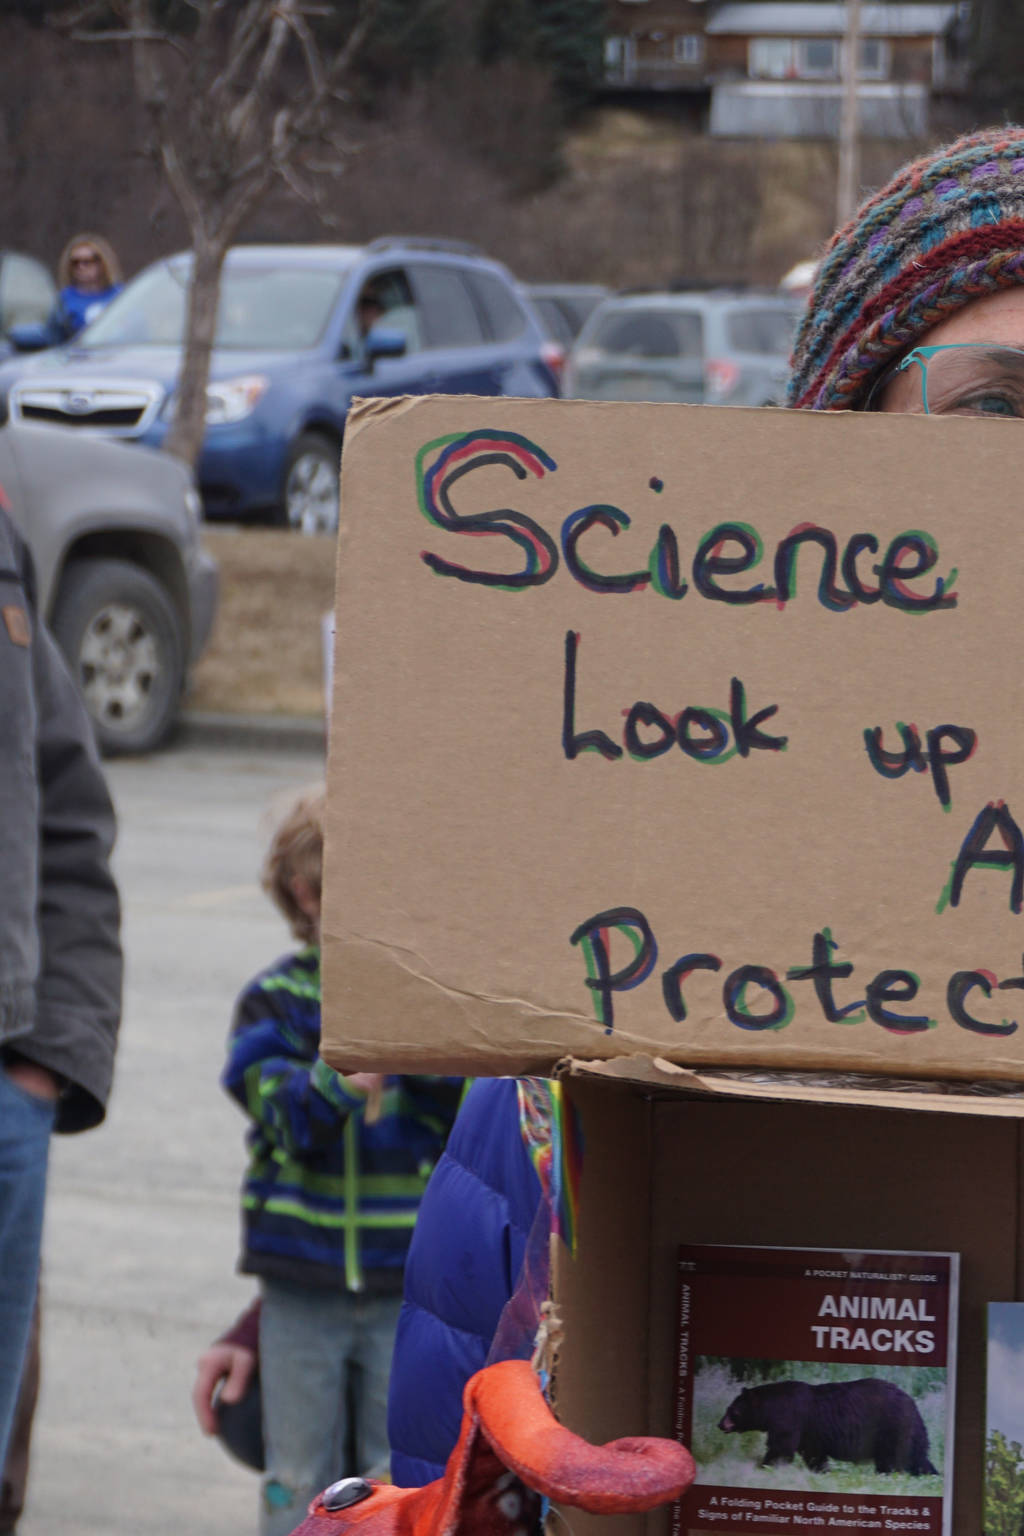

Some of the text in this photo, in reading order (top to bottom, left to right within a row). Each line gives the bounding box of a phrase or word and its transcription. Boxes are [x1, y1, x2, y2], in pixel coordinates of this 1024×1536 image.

[414, 429, 958, 613] Science
[562, 630, 788, 765] Look
[863, 721, 977, 812] up
[805, 1269, 812, 1277] A
[813, 1270, 849, 1280] POCKET
[909, 1273, 938, 1282] GUIDE
[680, 1284, 690, 1326] ANIMAL
[818, 1295, 936, 1322] ANIMAL
[678, 1331, 689, 1377] TRACKS
[810, 1325, 935, 1354] TRACKS
[697, 1509, 930, 1531] Signs of Familiar North American Species
[709, 1497, 930, 1516] A Folding Pocket Guide to the Tracks &
